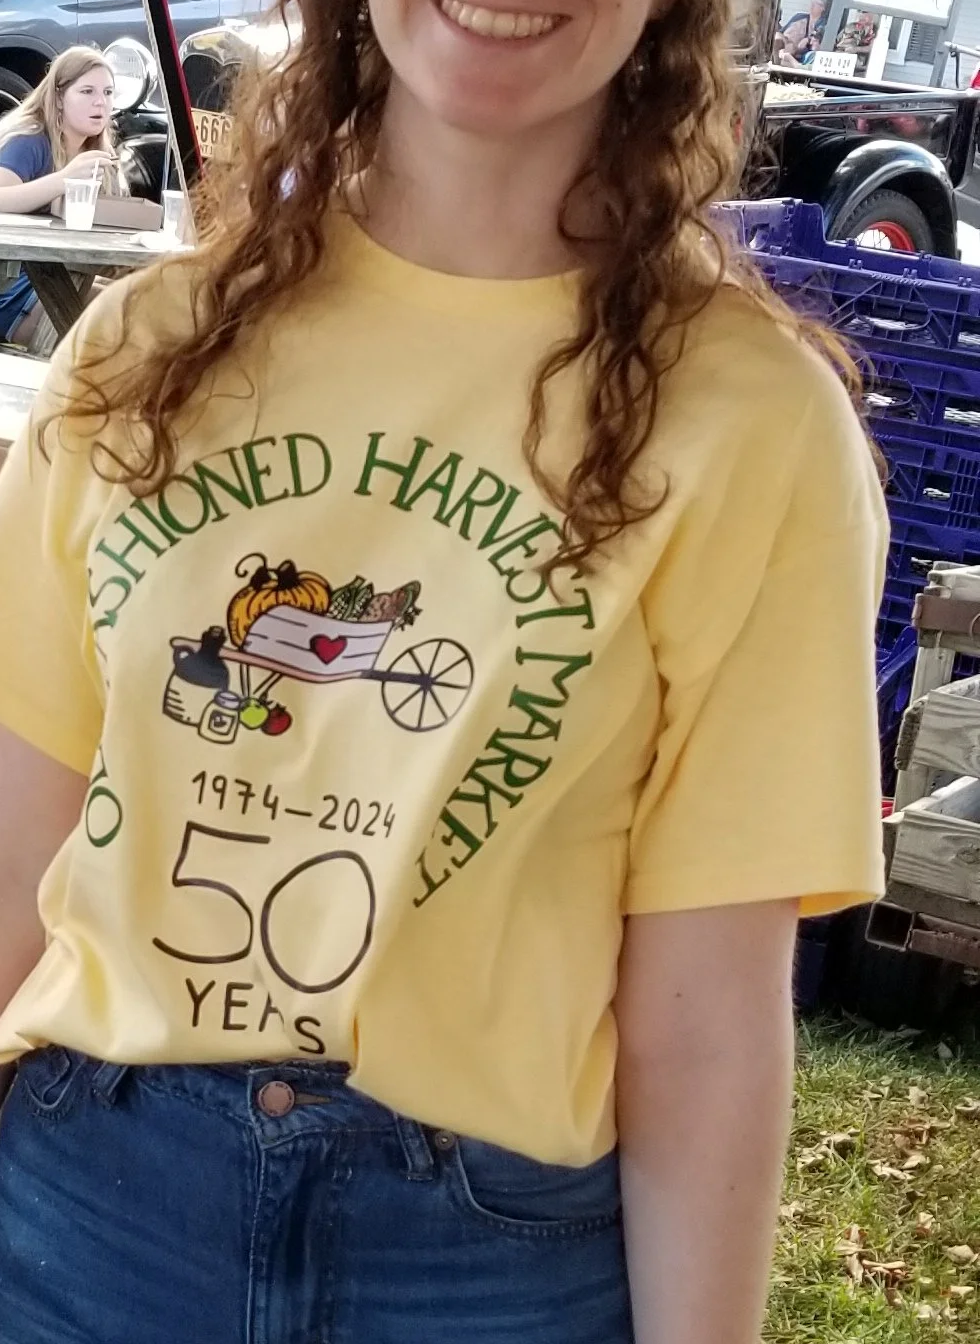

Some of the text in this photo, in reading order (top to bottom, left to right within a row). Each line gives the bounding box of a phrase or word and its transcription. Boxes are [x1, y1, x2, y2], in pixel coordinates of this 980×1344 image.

[86, 432, 333, 634] SHIONED
[152, 820, 376, 994] 50
[185, 977, 326, 1055] YEAS
